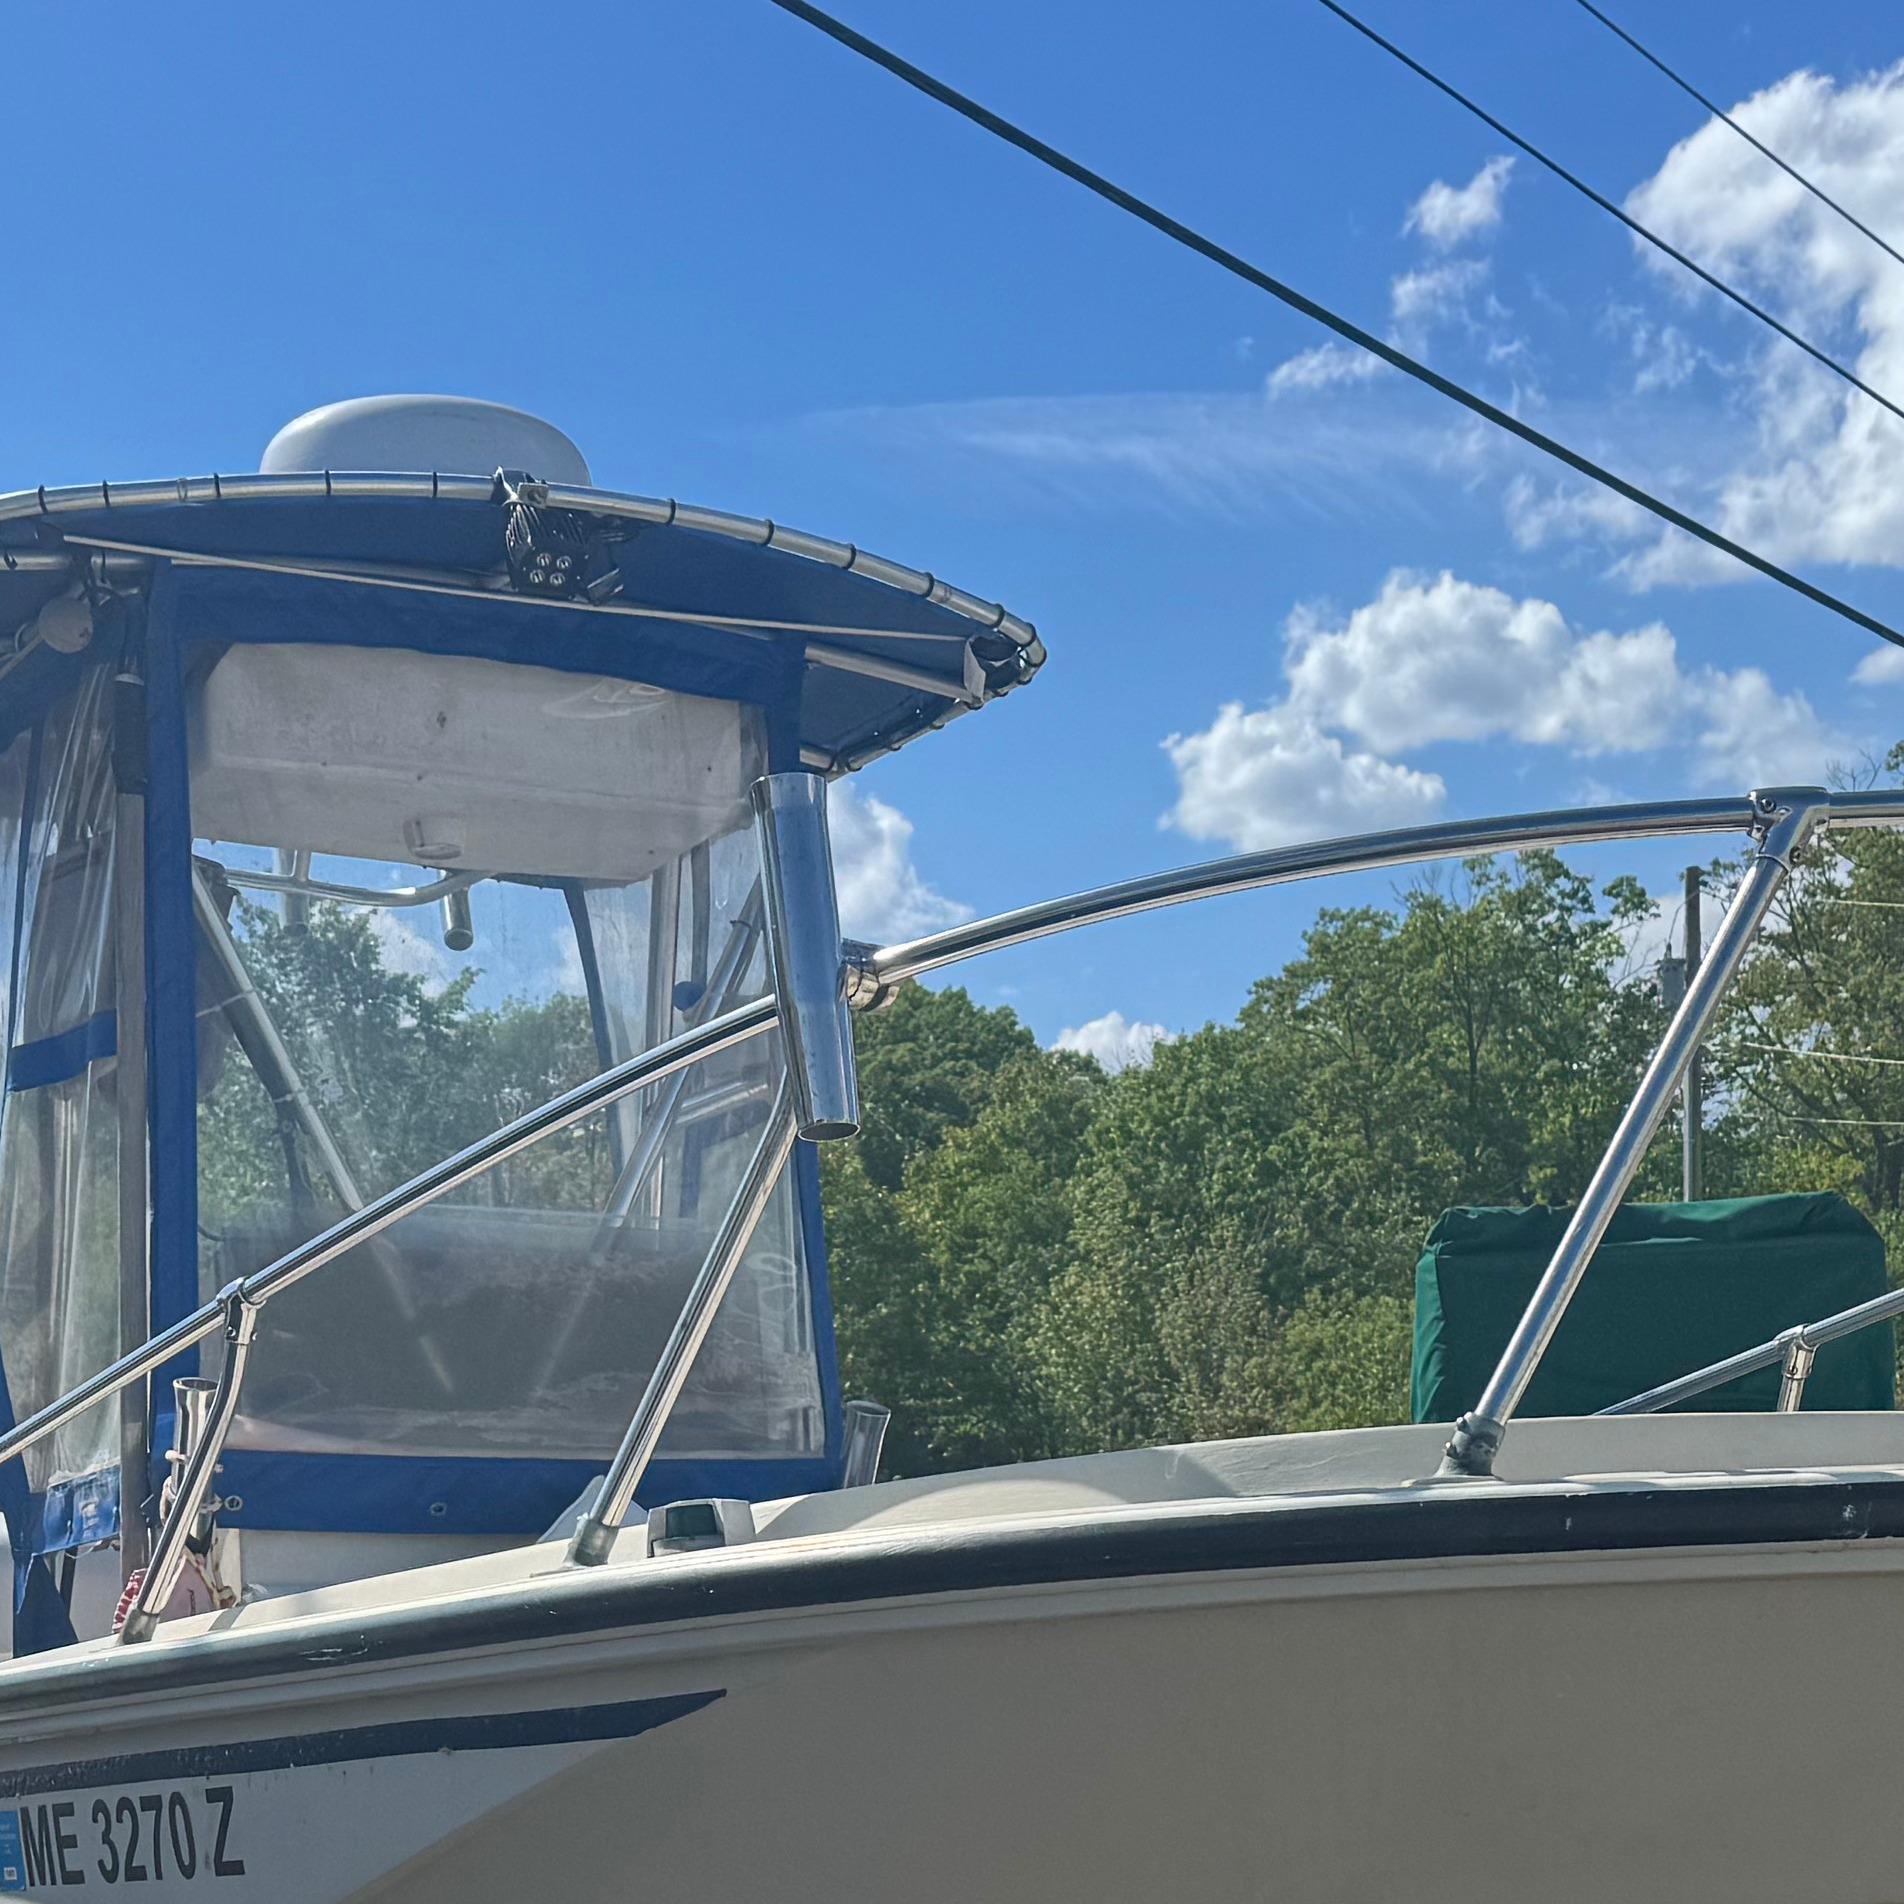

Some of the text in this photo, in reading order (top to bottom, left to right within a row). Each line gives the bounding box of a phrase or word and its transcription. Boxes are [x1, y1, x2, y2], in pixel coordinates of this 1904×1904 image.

[19, 1801, 86, 1888] ME
[92, 1790, 196, 1884] 3270
[205, 1785, 246, 1877] Z
